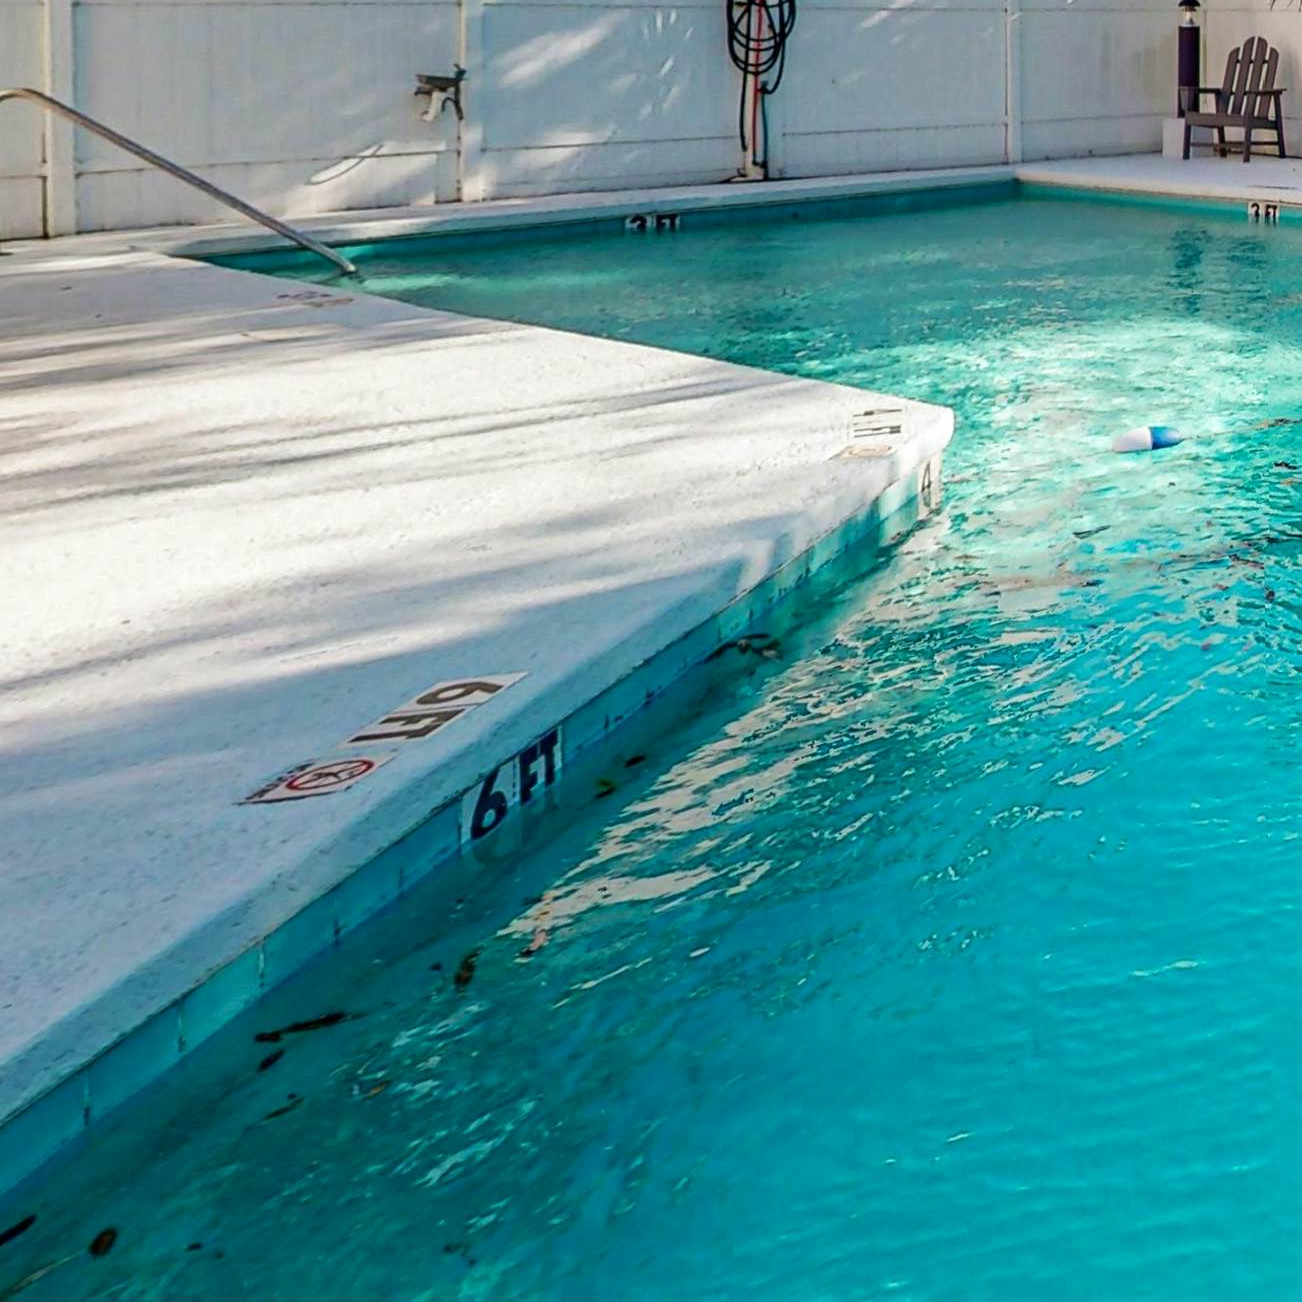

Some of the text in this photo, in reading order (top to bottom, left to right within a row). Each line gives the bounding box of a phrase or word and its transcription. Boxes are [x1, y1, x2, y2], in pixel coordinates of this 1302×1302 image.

[349, 681, 504, 743] 6 FT
[470, 728, 560, 840] 6 FT
